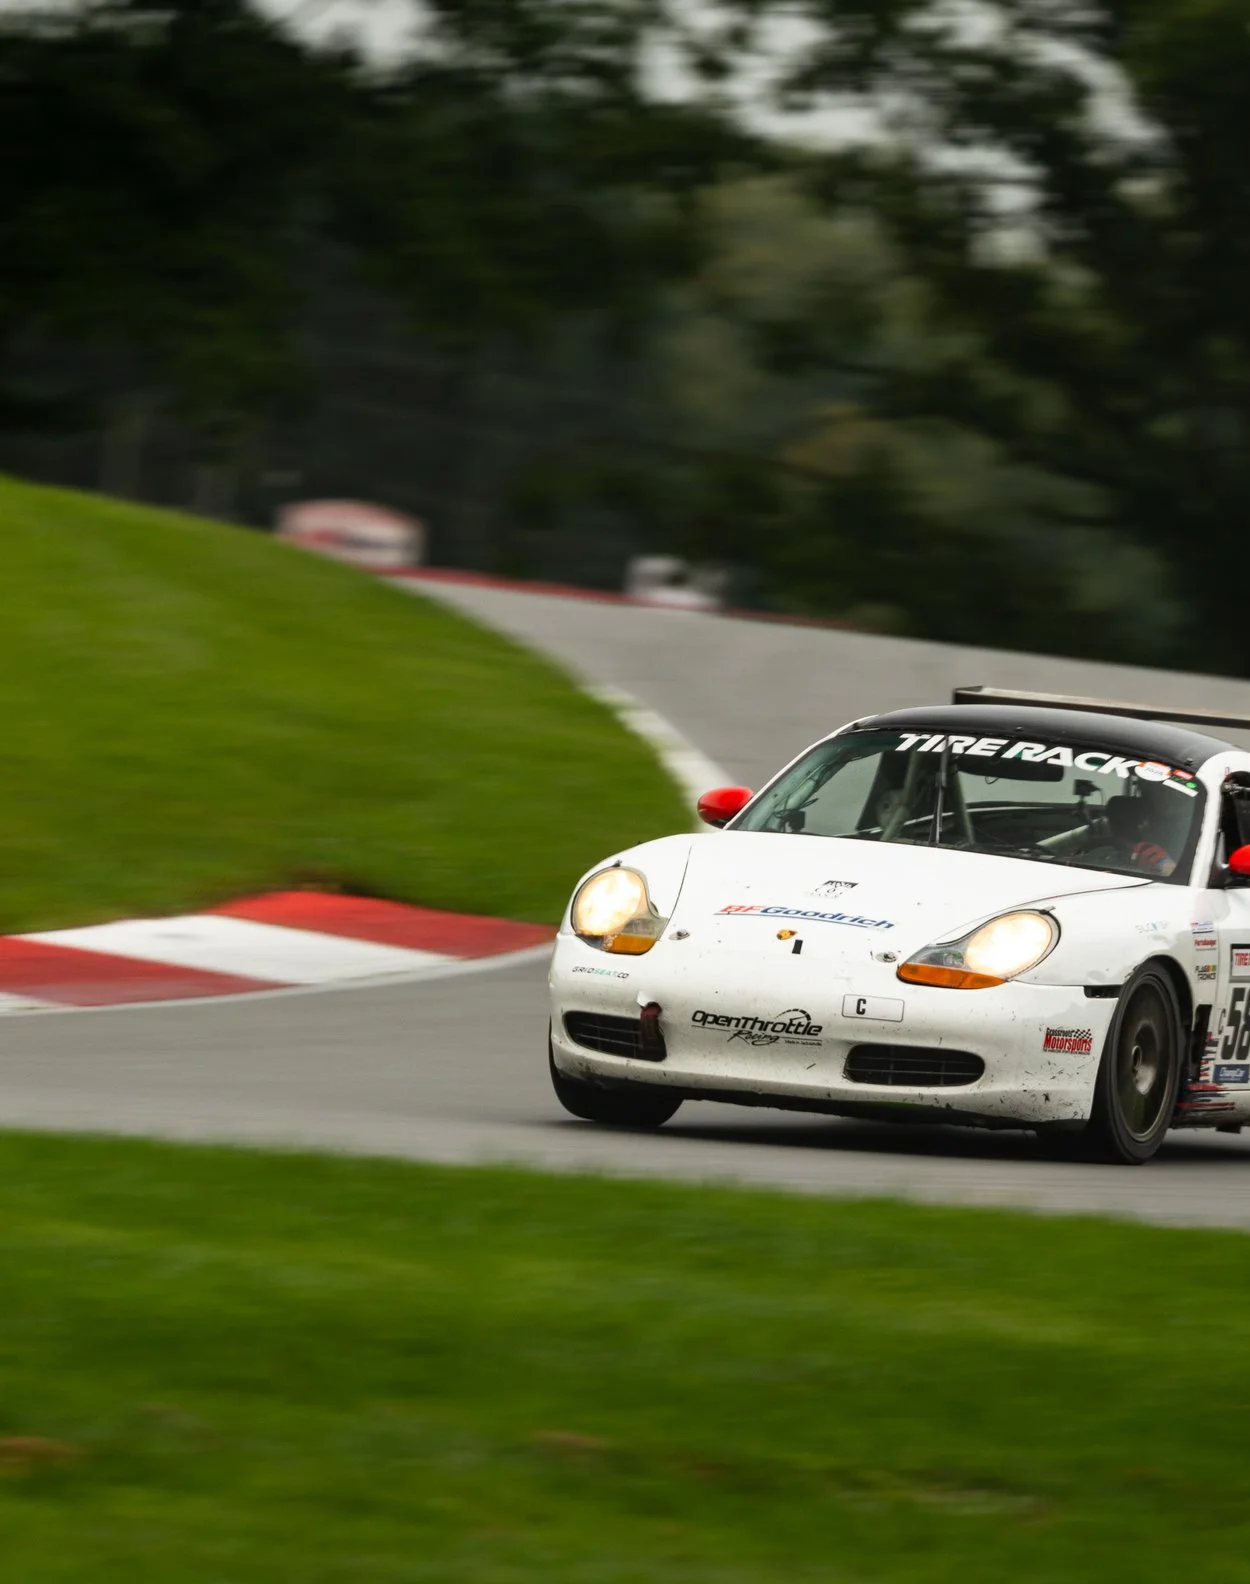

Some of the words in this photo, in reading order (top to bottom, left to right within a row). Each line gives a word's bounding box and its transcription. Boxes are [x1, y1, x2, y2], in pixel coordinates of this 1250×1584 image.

[895, 733, 1009, 756] TIRE
[1001, 740, 1140, 778] RACK
[720, 904, 895, 929] BFGoodrich
[856, 998, 867, 1015] C
[727, 1029, 780, 1046] Racing
